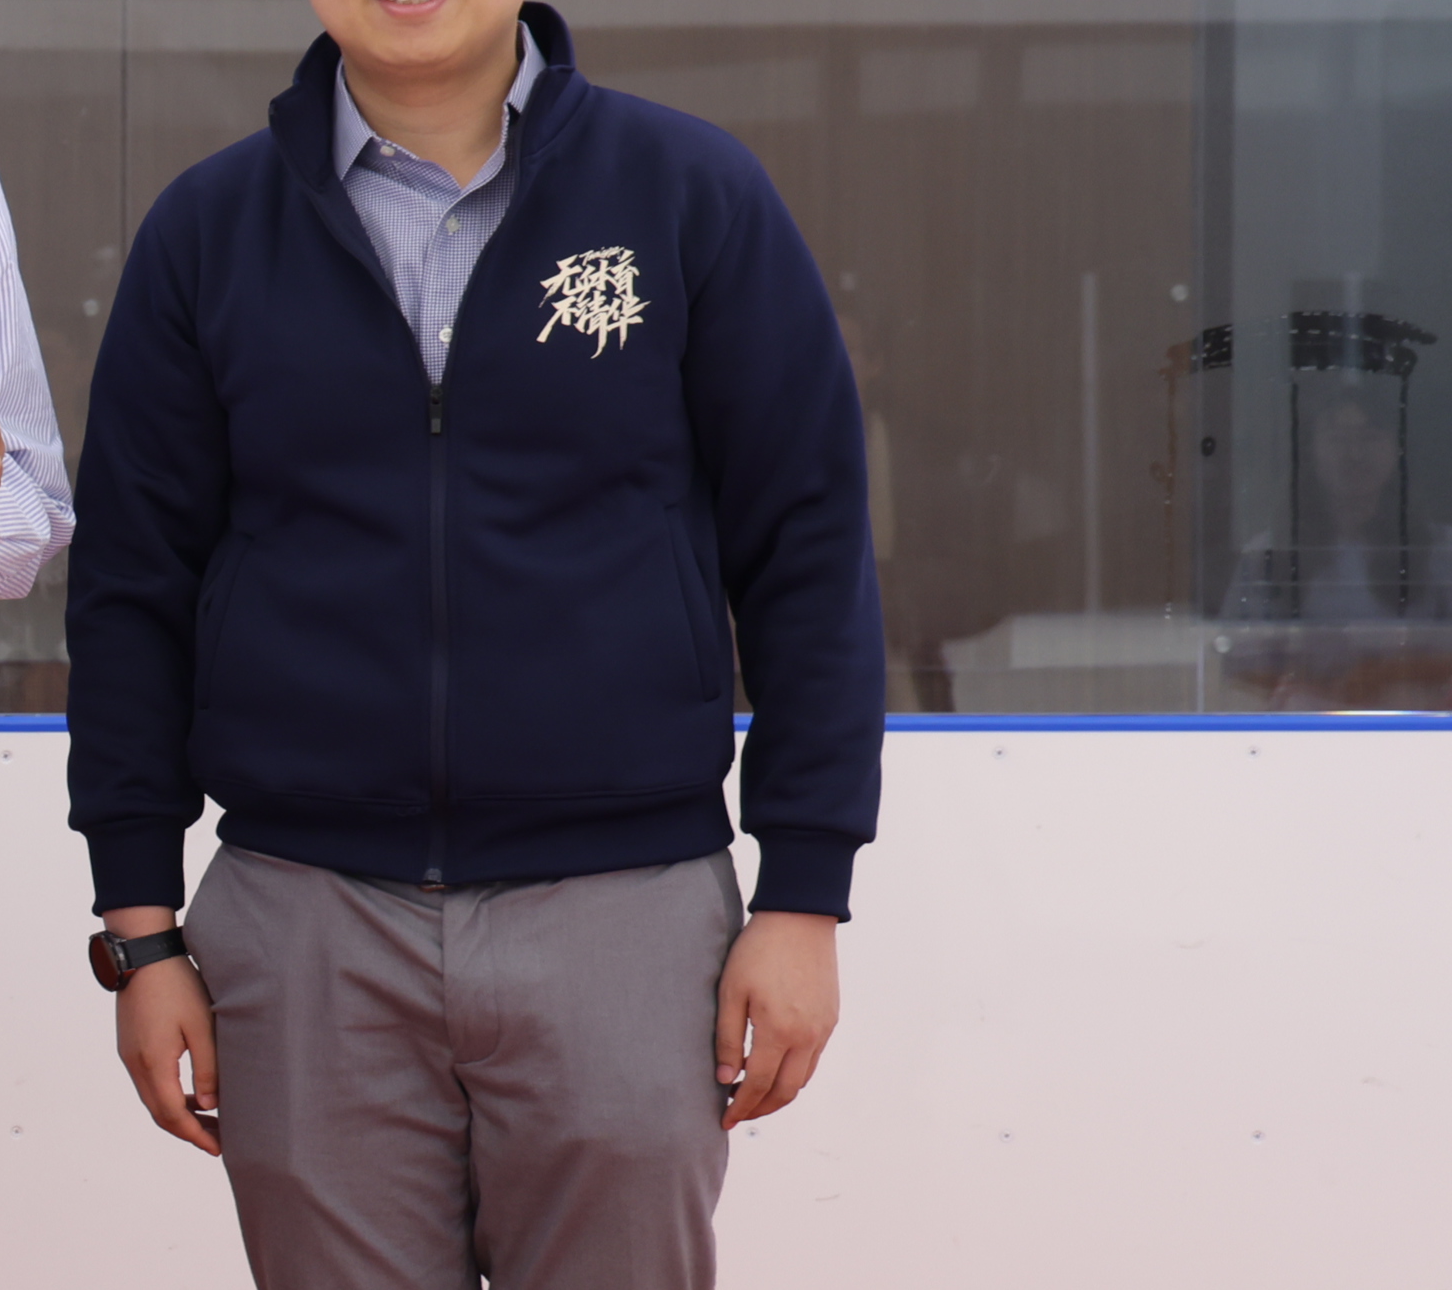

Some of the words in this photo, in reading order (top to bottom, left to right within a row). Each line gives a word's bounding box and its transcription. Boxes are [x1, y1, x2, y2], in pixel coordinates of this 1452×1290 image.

[538, 249, 640, 308] 无体育
[536, 290, 651, 359] 不清华
